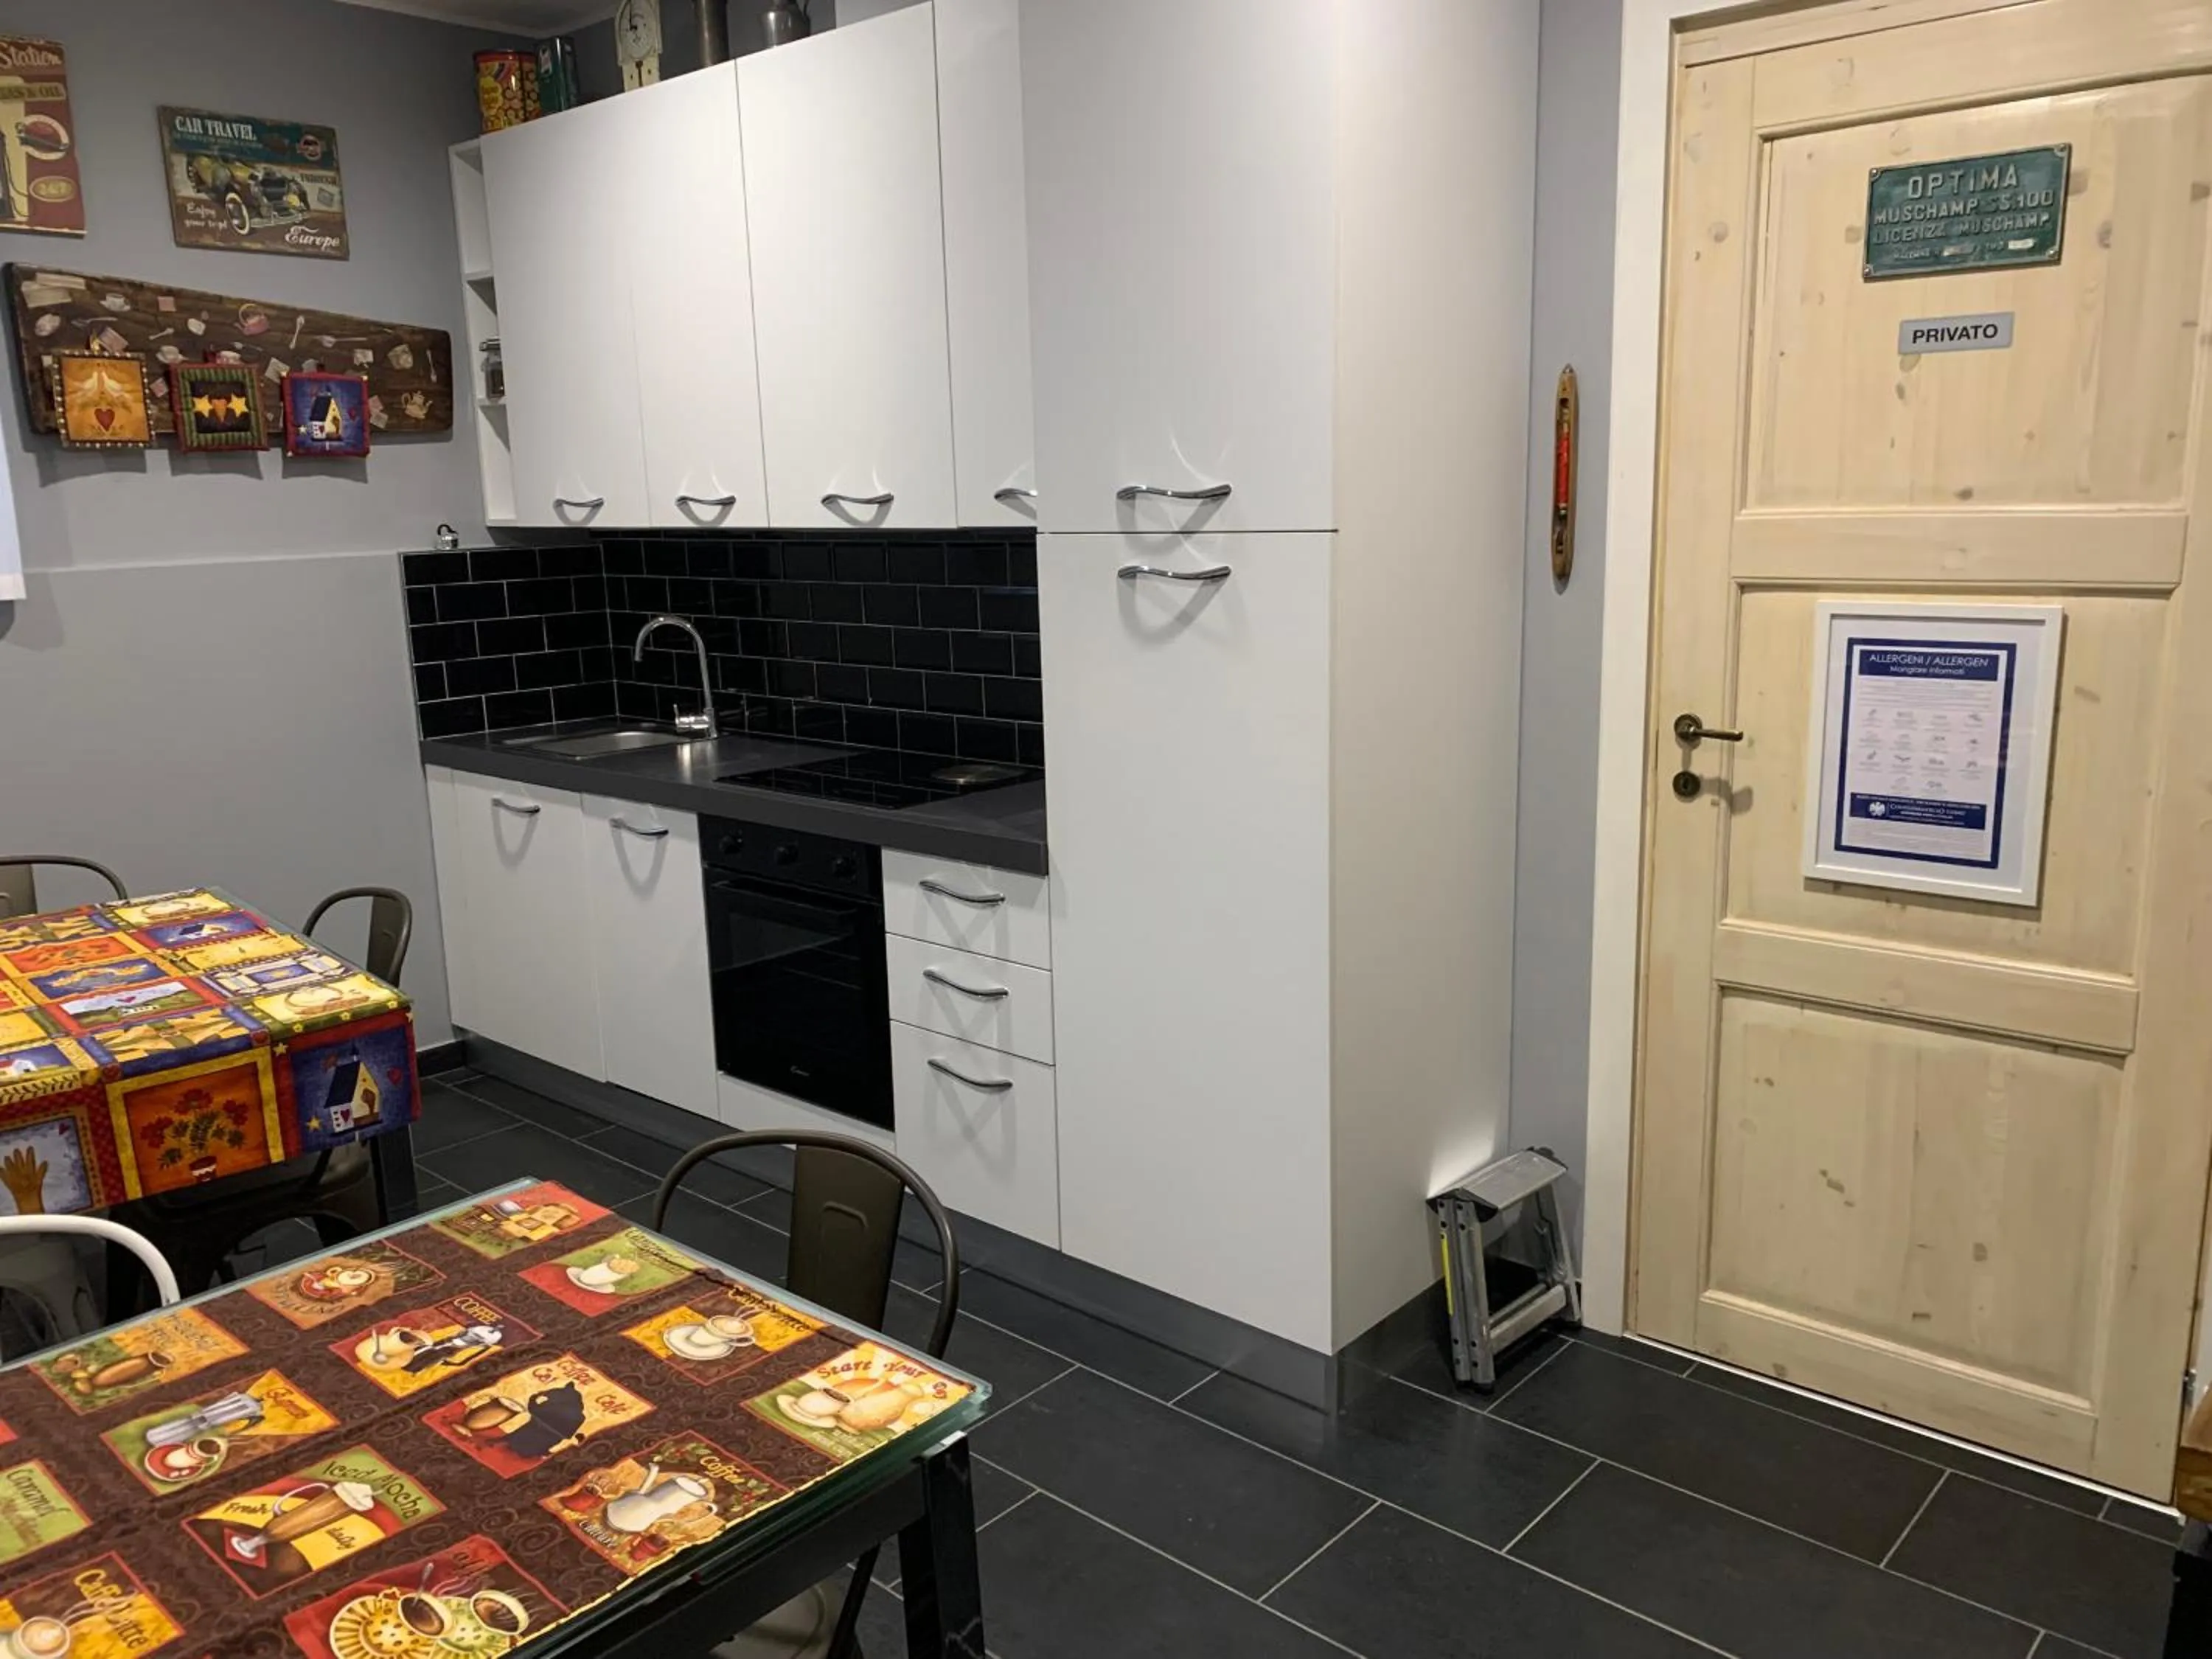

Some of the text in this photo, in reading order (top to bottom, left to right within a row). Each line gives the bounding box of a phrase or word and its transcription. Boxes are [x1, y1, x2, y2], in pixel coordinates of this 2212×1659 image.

[175, 116, 204, 134] CAR
[204, 119, 257, 141] TRAVEL
[1908, 164, 2018, 198] OPTIMA
[1874, 198, 1979, 225] MUSCHAMP
[1959, 212, 2051, 234] MUSCHAMP
[285, 226, 340, 251] Europe
[1912, 324, 1999, 344] PRIVATO
[1869, 653, 1924, 665] ALLERGENI
[453, 1297, 504, 1325] COFFEE
[816, 1360, 873, 1379] Start
[699, 1454, 745, 1486] Coffee
[321, 1459, 424, 1520] Iced Mocha
